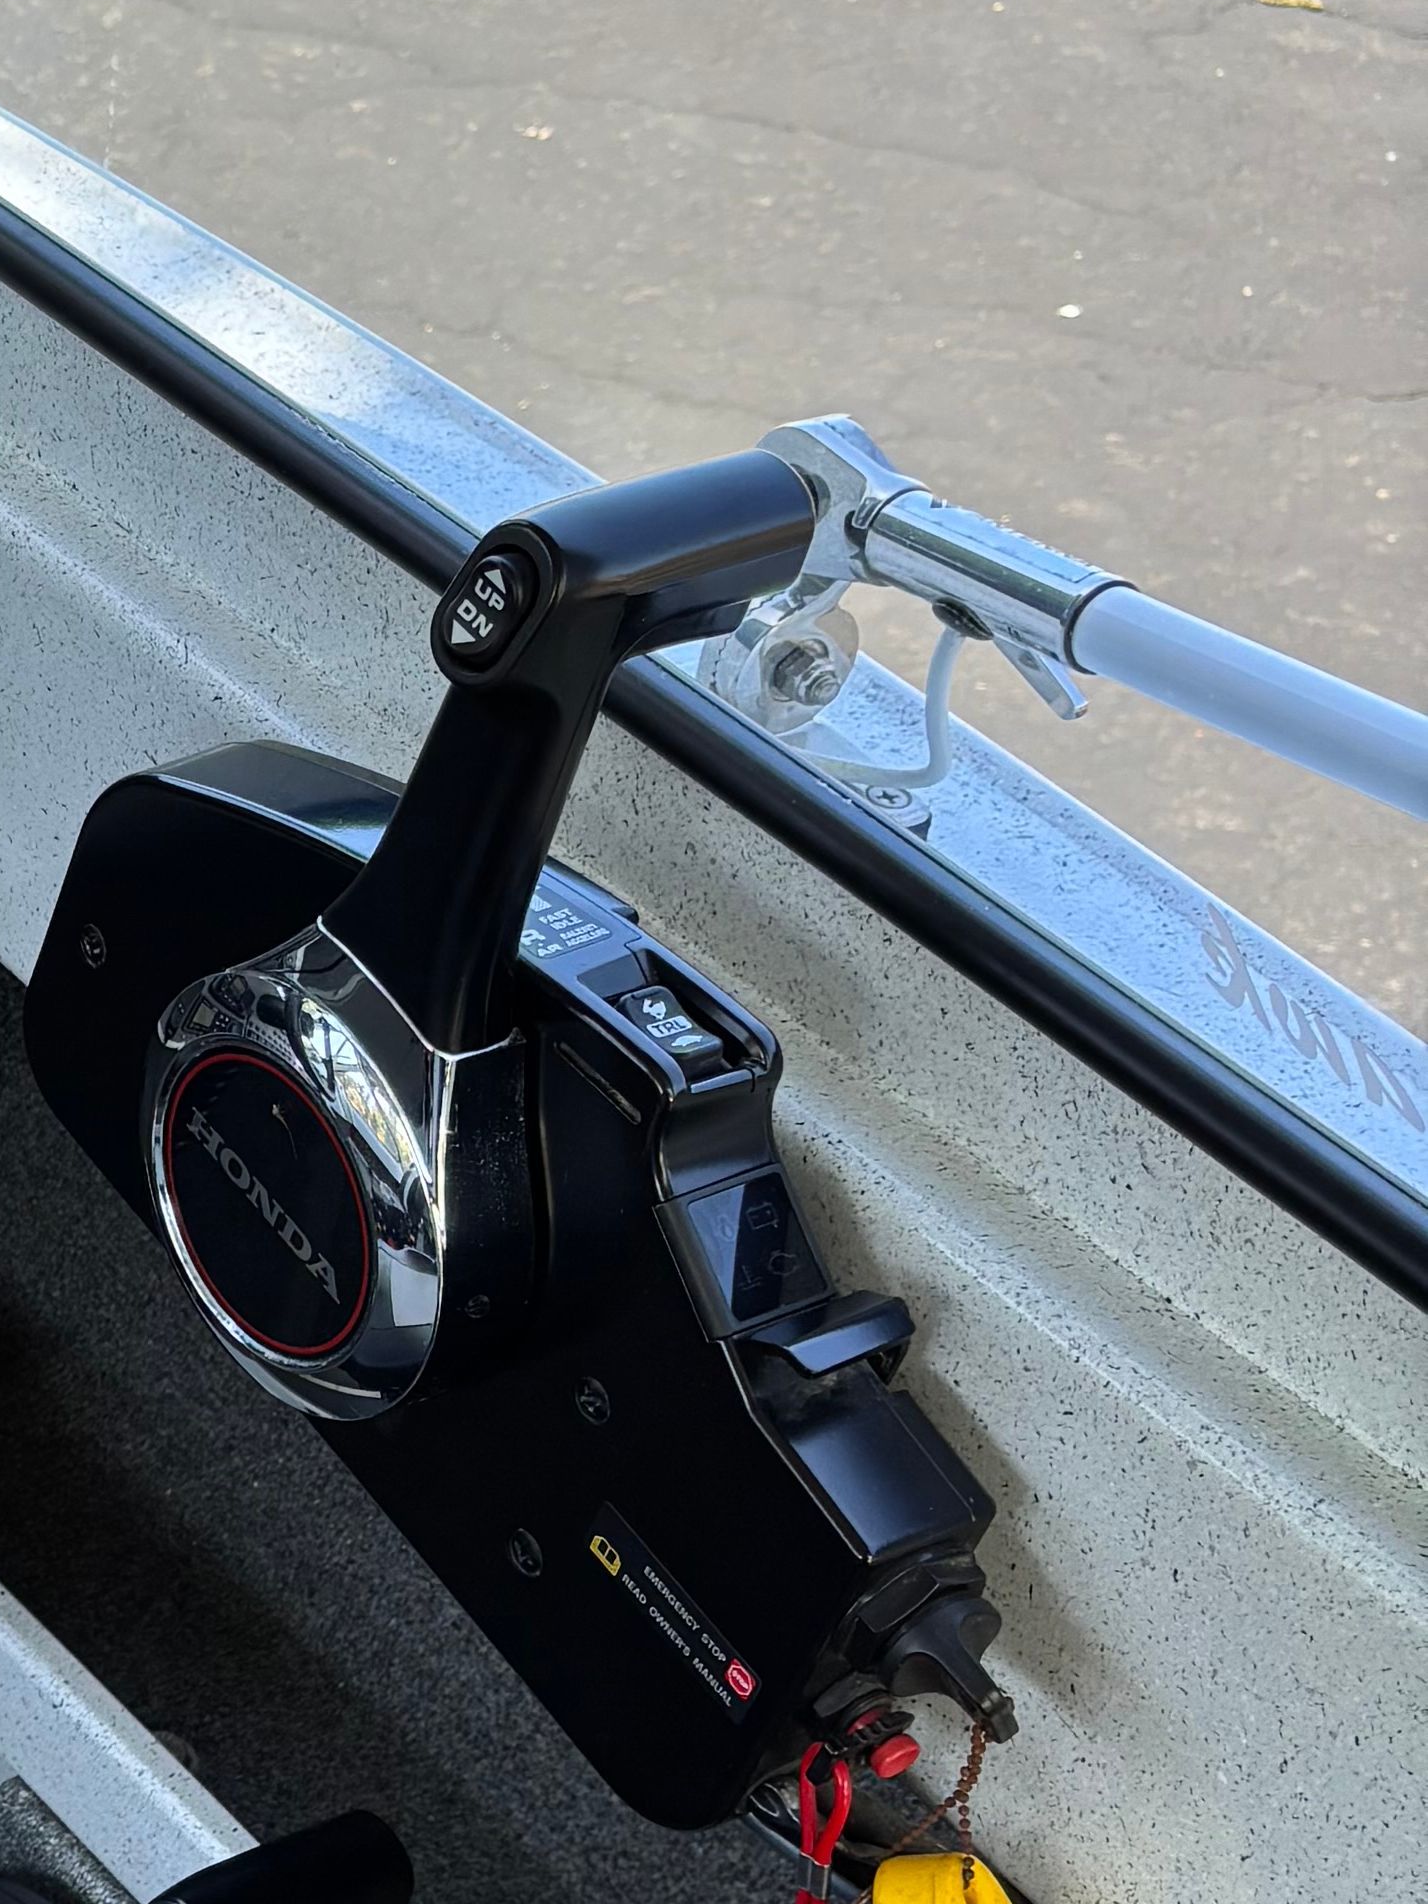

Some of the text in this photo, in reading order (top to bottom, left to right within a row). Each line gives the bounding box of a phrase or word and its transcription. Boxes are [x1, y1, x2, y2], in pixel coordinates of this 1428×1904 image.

[474, 577, 505, 611] UP
[456, 598, 494, 638] DN
[538, 908, 572, 925] FAST
[651, 1020, 686, 1034] TRL
[186, 1106, 340, 1305] HONDA
[644, 1566, 727, 1662] EMERGENCY STOP
[621, 1574, 731, 1707] READ OWNER'S MANUAL
